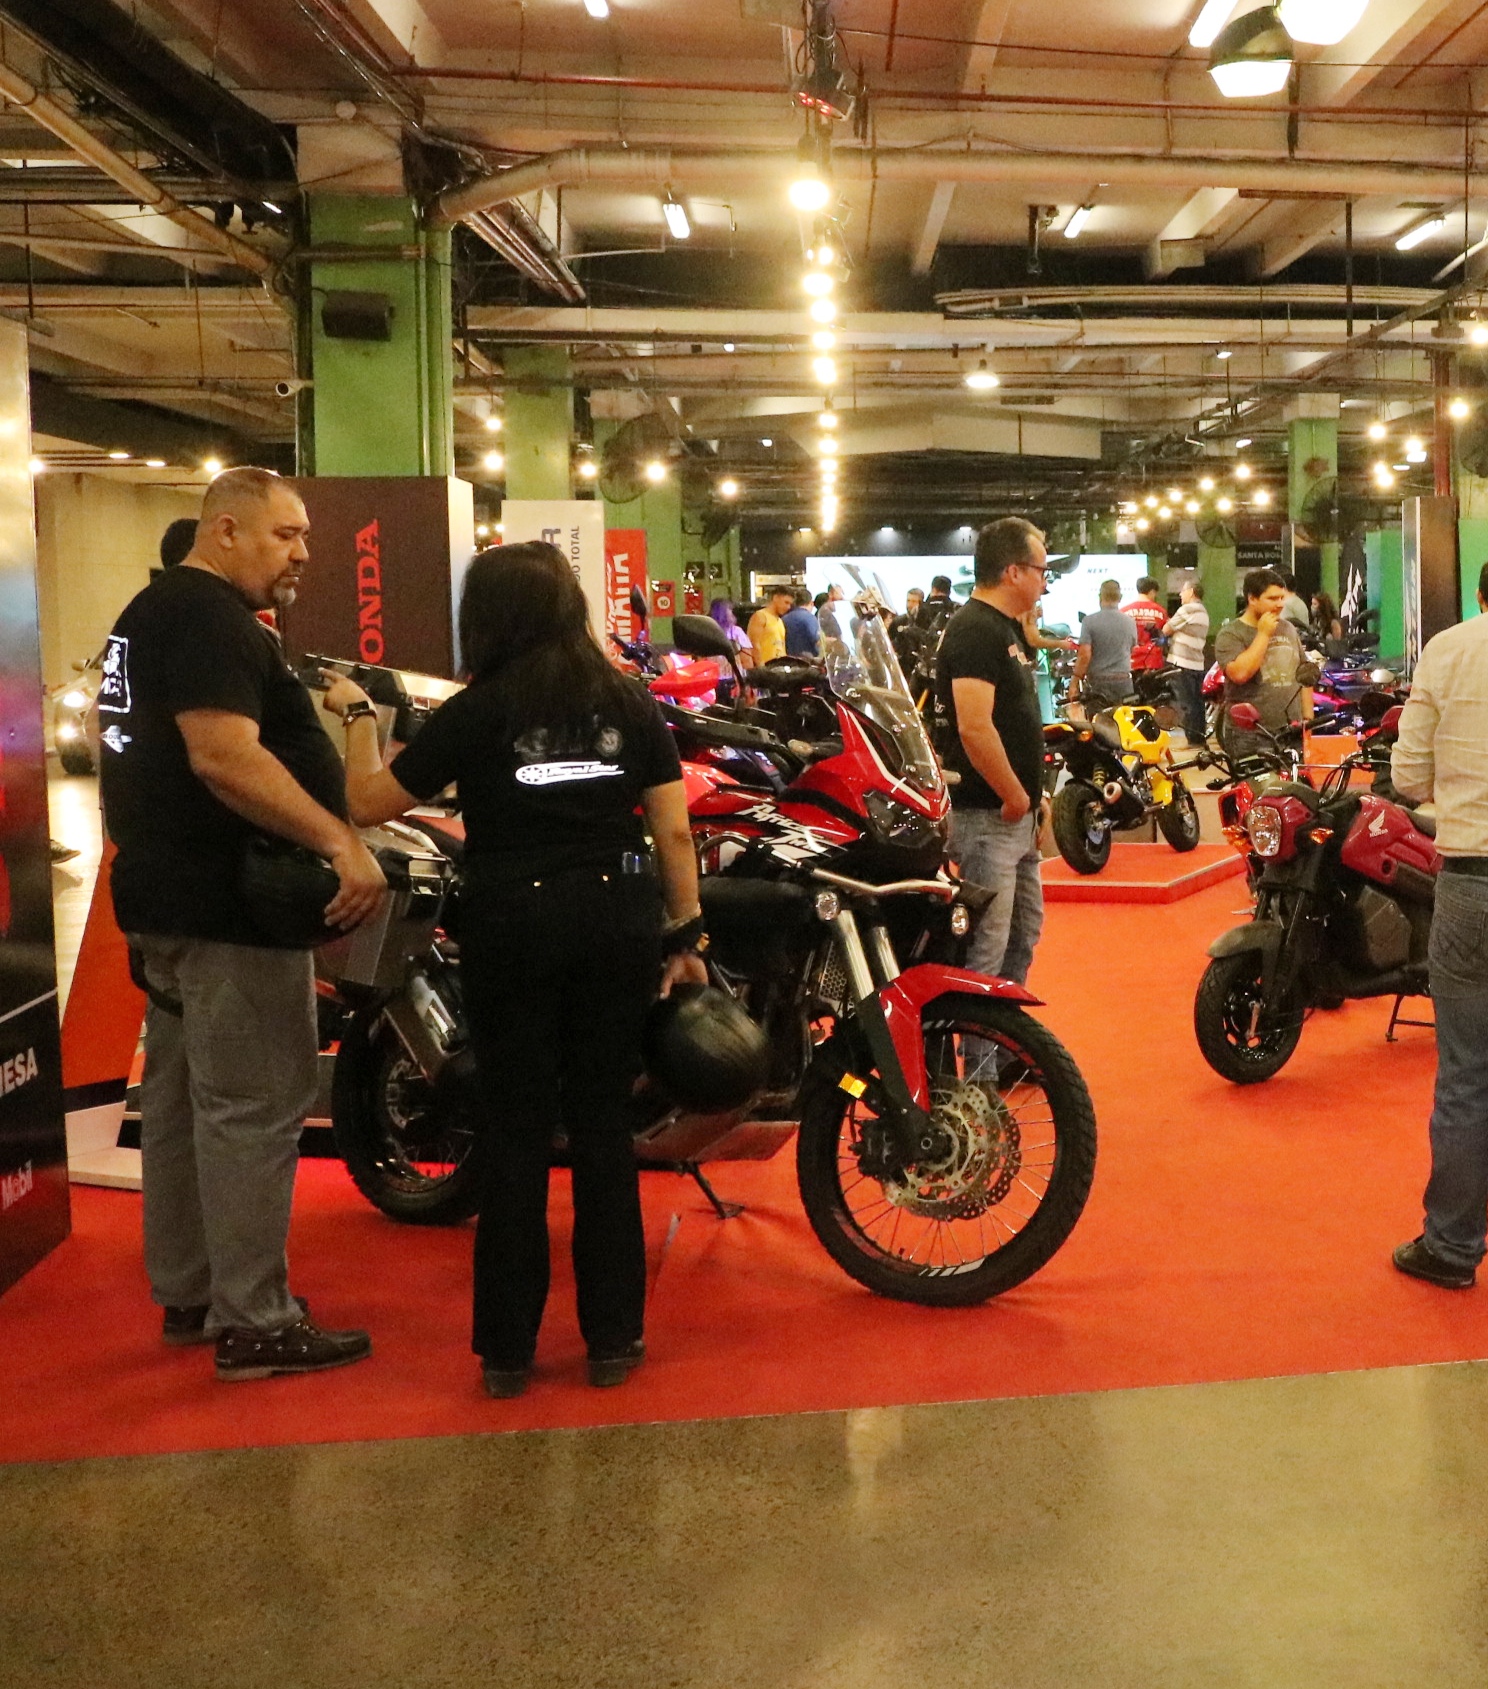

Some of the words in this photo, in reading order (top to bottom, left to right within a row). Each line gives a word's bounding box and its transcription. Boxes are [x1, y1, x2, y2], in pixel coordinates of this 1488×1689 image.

[570, 526, 580, 561] TOTAL
[355, 518, 385, 664] ONDA
[2, 1159, 33, 1211] Mobil
